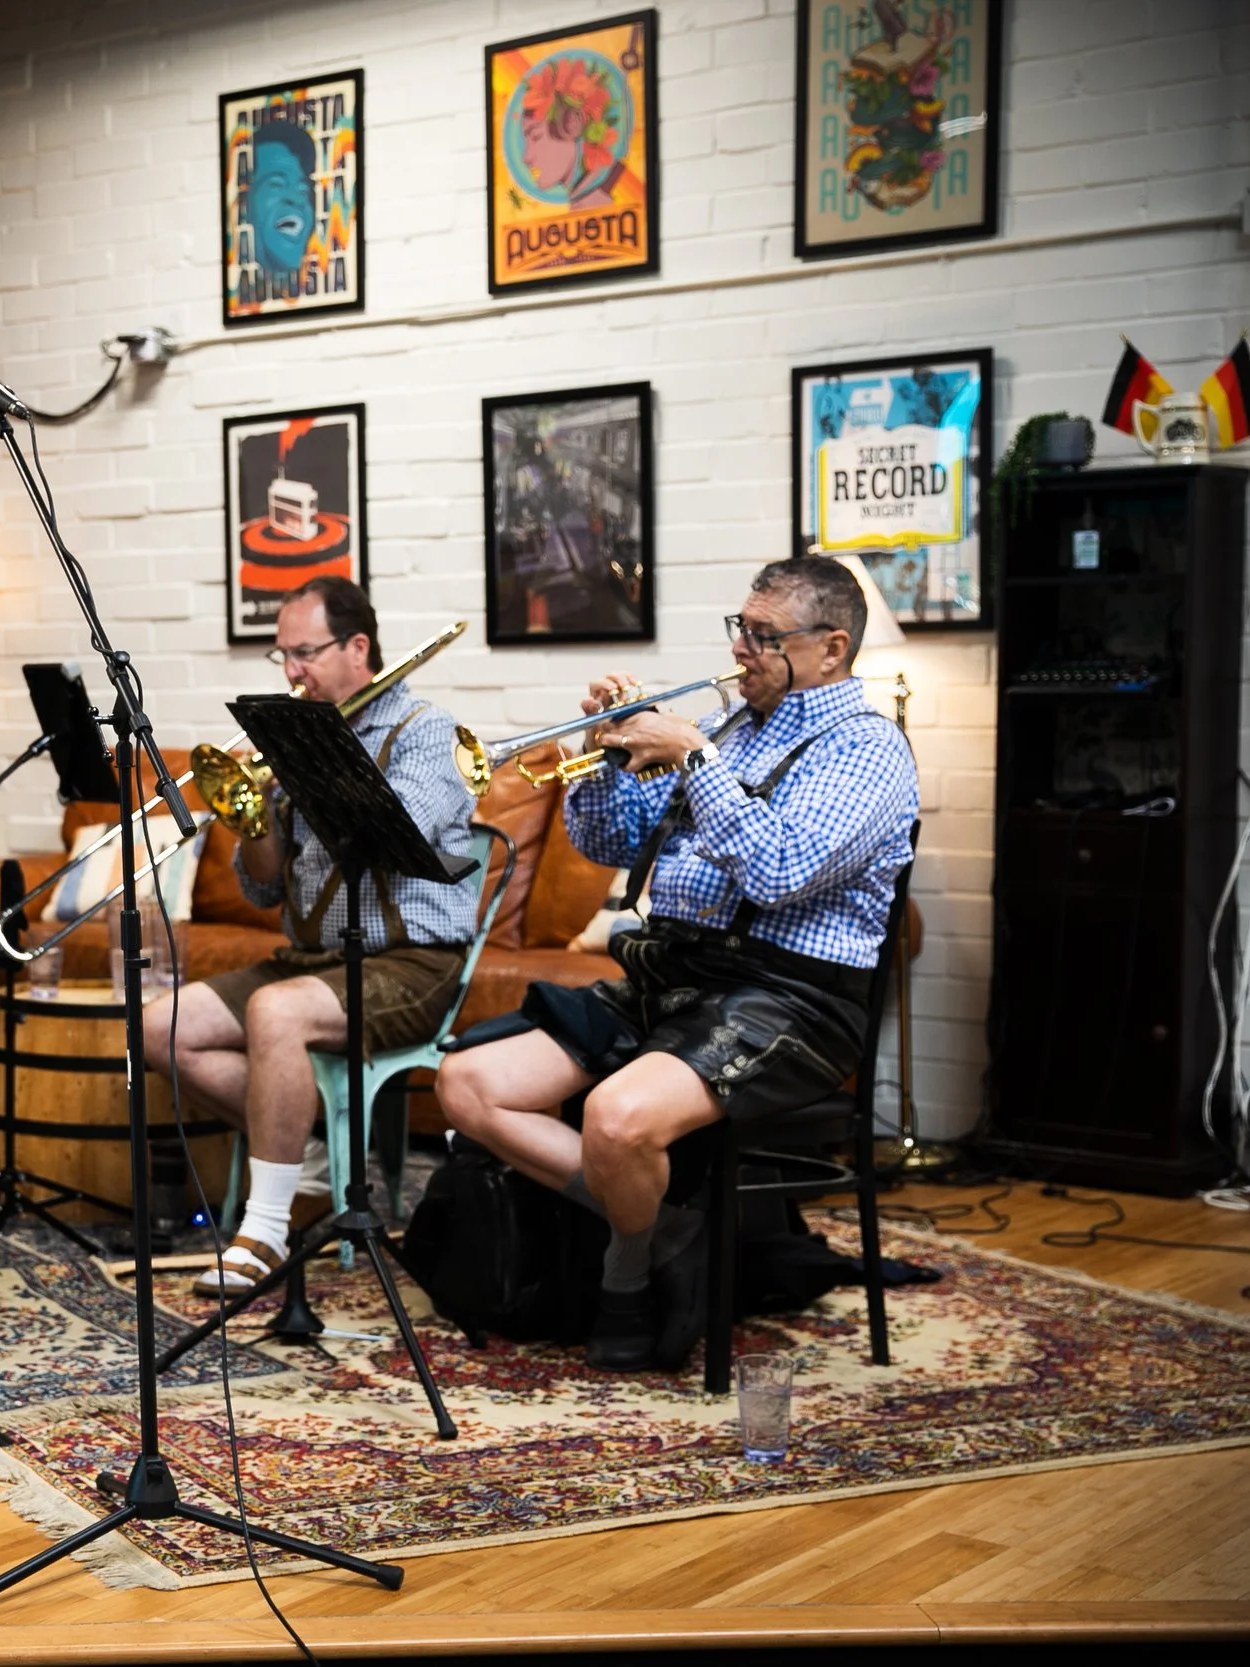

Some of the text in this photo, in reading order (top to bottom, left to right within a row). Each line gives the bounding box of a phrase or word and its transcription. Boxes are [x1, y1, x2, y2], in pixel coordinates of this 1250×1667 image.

[507, 209, 638, 268] AUGUSTA
[858, 444, 918, 465] SECRET
[834, 463, 948, 501] RECORD
[860, 503, 916, 519] NIGHT
